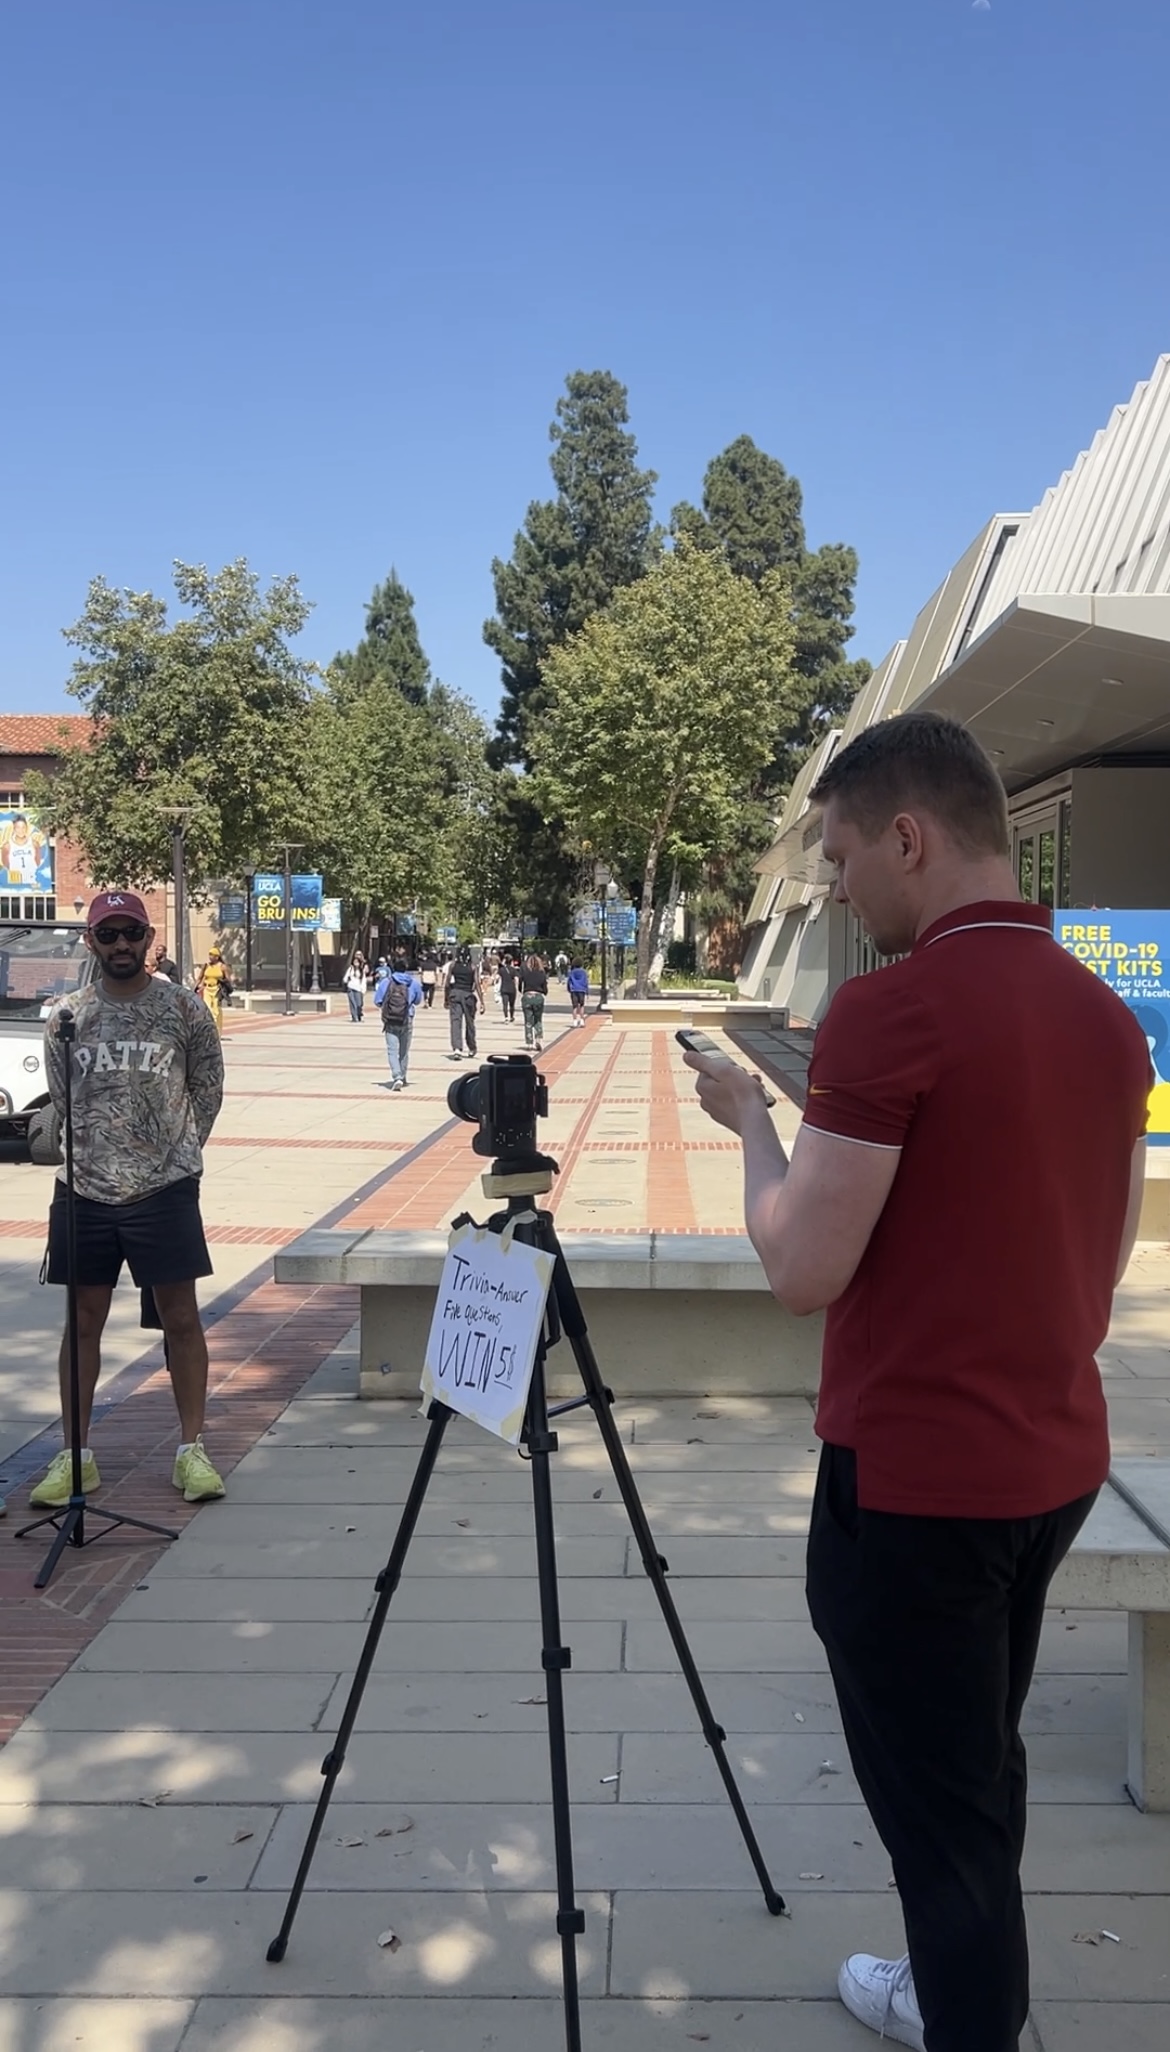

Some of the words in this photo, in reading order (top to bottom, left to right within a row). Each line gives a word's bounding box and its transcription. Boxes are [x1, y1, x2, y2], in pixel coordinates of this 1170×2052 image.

[258, 882, 281, 891] UCLA
[258, 895, 281, 907] GO
[1062, 925, 1111, 941] FREE
[1079, 960, 1111, 976] ST
[1117, 960, 1163, 976] KITS
[1116, 978, 1132, 987] for
[1134, 979, 1161, 988] UCLA
[1132, 989, 1140, 997] &
[1142, 988, 1170, 997] facult
[74, 1041, 175, 1077] PATTA
[443, 1299, 461, 1320] Five
[438, 1329, 497, 1393] WIN
